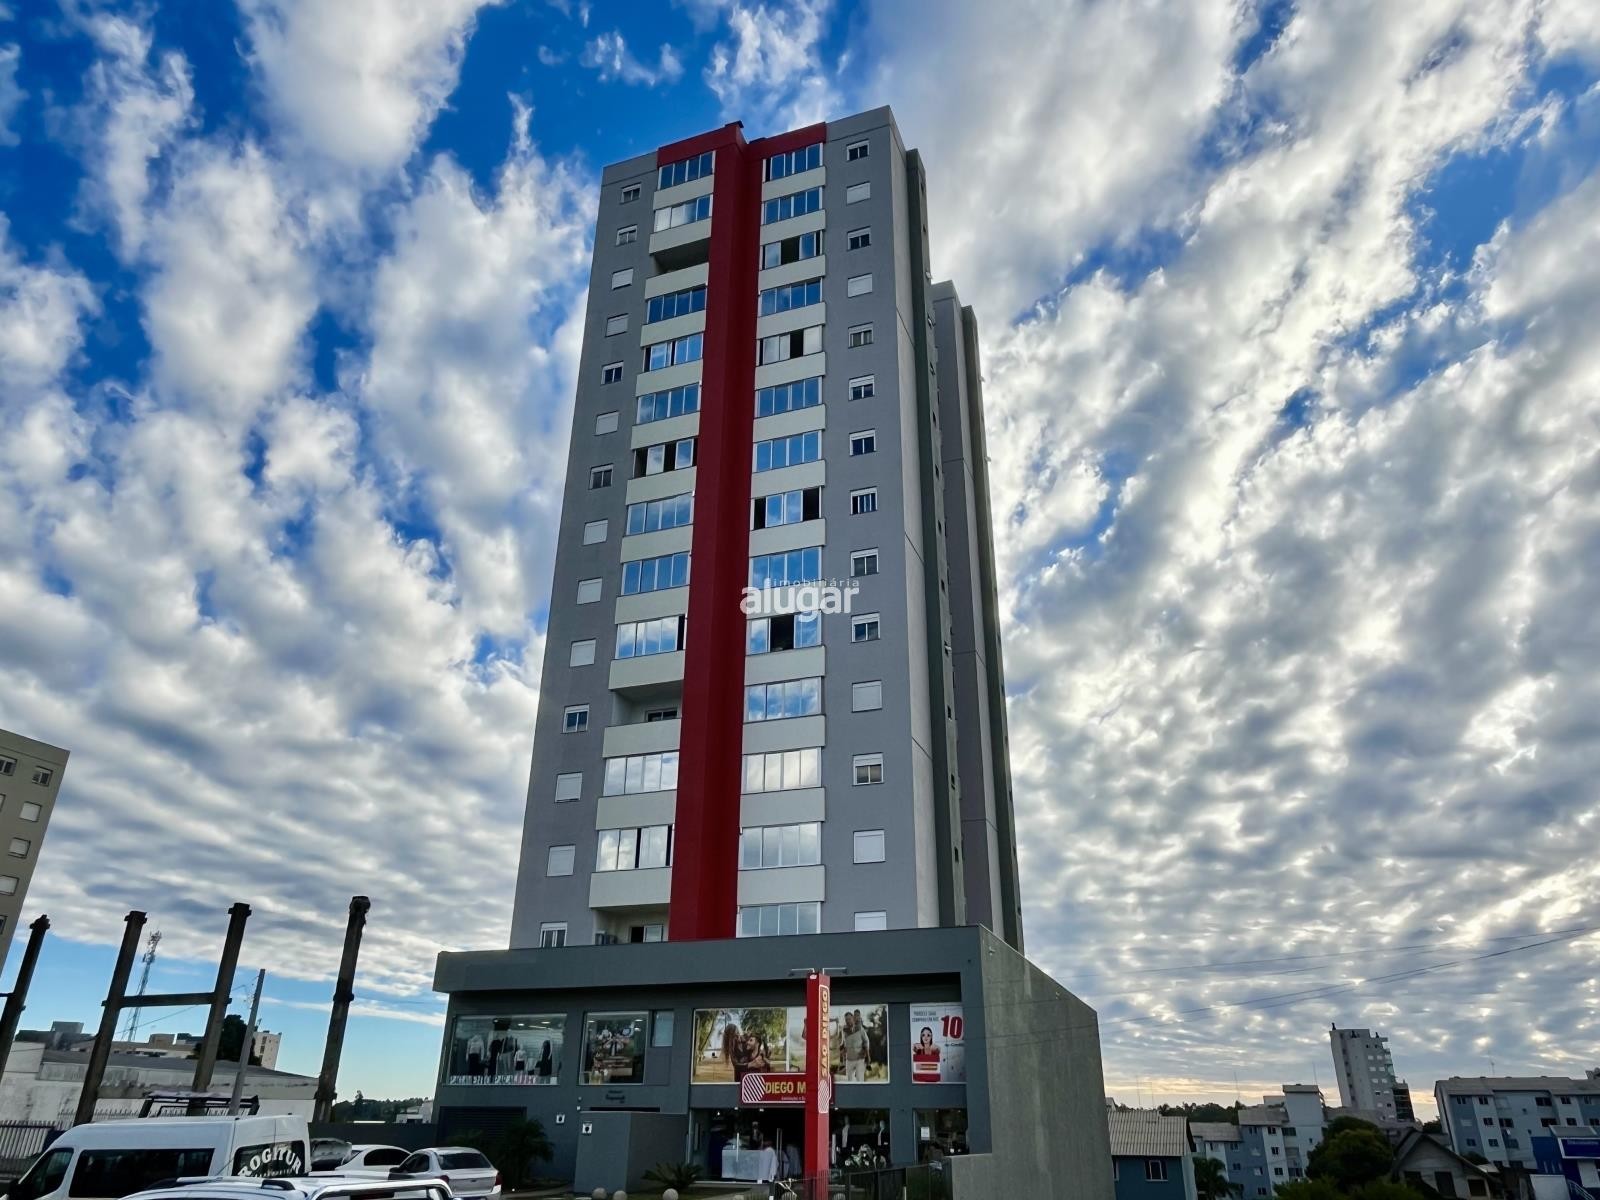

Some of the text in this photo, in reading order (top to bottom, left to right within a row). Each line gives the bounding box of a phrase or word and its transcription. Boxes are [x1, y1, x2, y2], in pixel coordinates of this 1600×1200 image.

[941, 1016, 963, 1038] 10
[764, 1081, 806, 1094] DIEGO M
